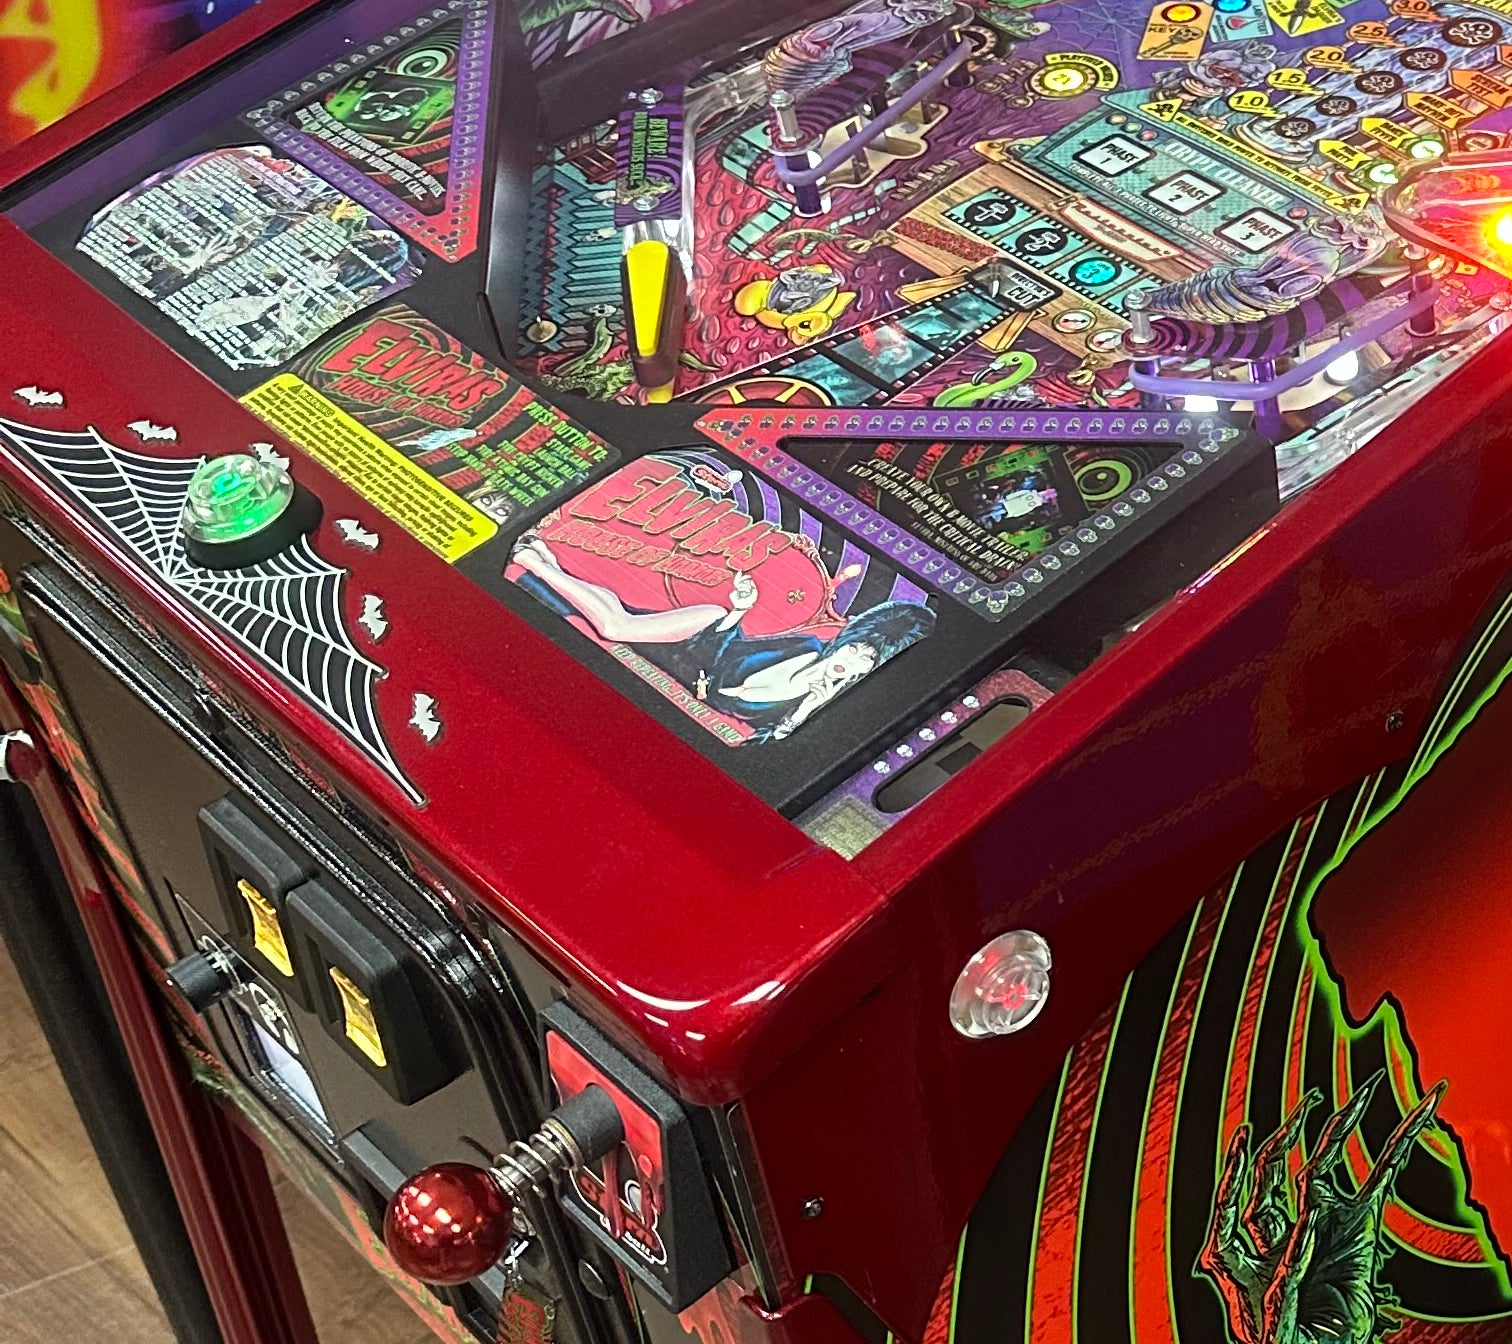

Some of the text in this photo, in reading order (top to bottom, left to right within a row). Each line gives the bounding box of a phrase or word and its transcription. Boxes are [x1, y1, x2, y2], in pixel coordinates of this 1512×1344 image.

[1396, 0, 1426, 13] 3.0
[1148, 24, 1176, 35] KEY
[1355, 24, 1385, 38] 2.5
[1315, 48, 1343, 63] 2.0
[1276, 71, 1304, 86] 1.5
[1234, 95, 1264, 108] 1.0
[647, 117, 669, 158] BEWARE!
[1100, 141, 1137, 164] PHASE
[1164, 140, 1284, 207] CRYPT CLEANER
[1169, 178, 1208, 202] PHASE
[1242, 216, 1281, 241] PHASE
[1008, 285, 1043, 308] CUT
[329, 376, 394, 404] HOUSE
[299, 392, 332, 416] WARNING
[522, 401, 555, 425] PRESS
[551, 422, 591, 449] BUTTON
[847, 461, 871, 480] AND
[868, 472, 911, 501] PREPARE
[906, 497, 927, 512] FOR
[922, 511, 943, 526] THE
[939, 525, 979, 552] CRITICAL
[868, 456, 905, 482] CREATE
[905, 478, 930, 496] YOUR
[926, 493, 951, 510] OWN
[954, 515, 985, 536] MOVIE
